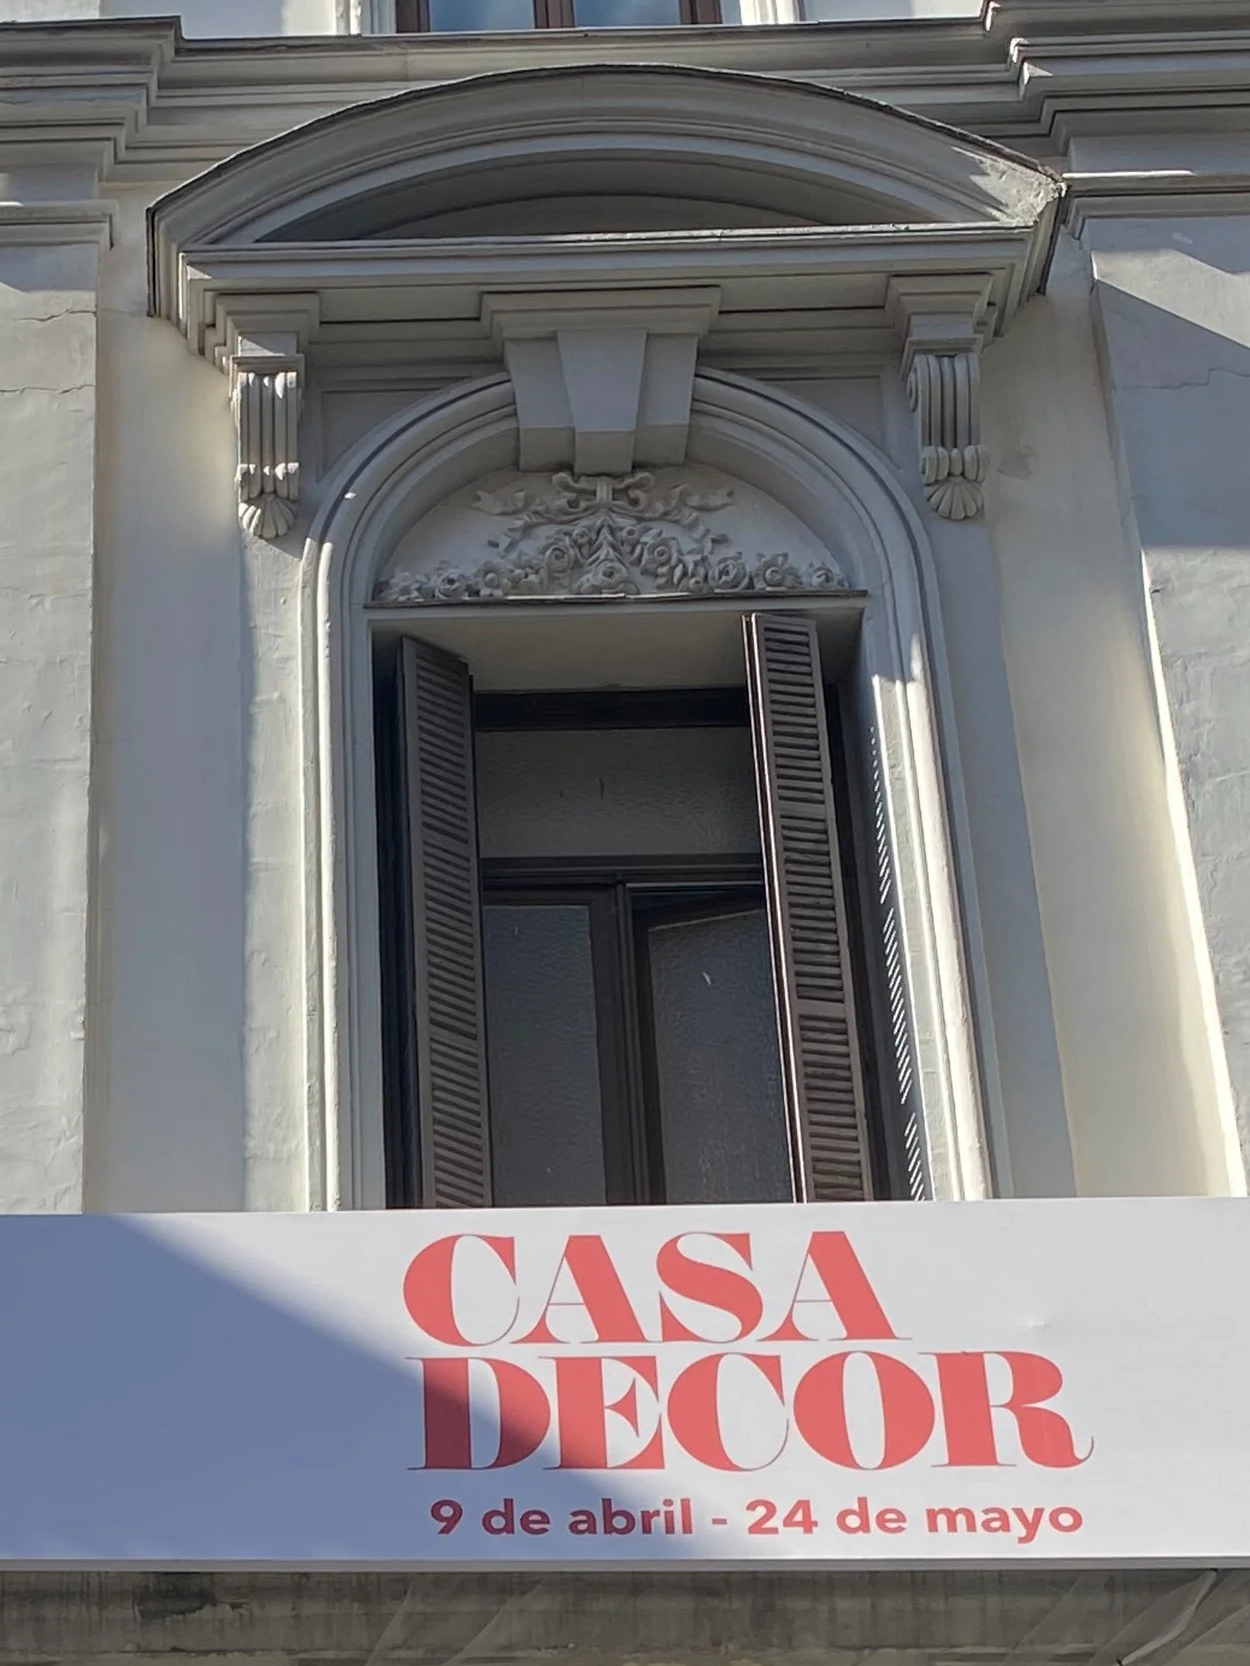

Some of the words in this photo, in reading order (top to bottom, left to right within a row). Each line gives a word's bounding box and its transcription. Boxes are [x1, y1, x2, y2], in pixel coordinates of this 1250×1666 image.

[402, 1230, 912, 1347] CASA
[407, 1350, 1095, 1473] DECOR
[429, 1498, 464, 1535] 9
[482, 1498, 550, 1535] de
[568, 1497, 693, 1535] abril
[746, 1498, 818, 1535] 24
[836, 1495, 907, 1534] de
[925, 1505, 1084, 1544] mayo
